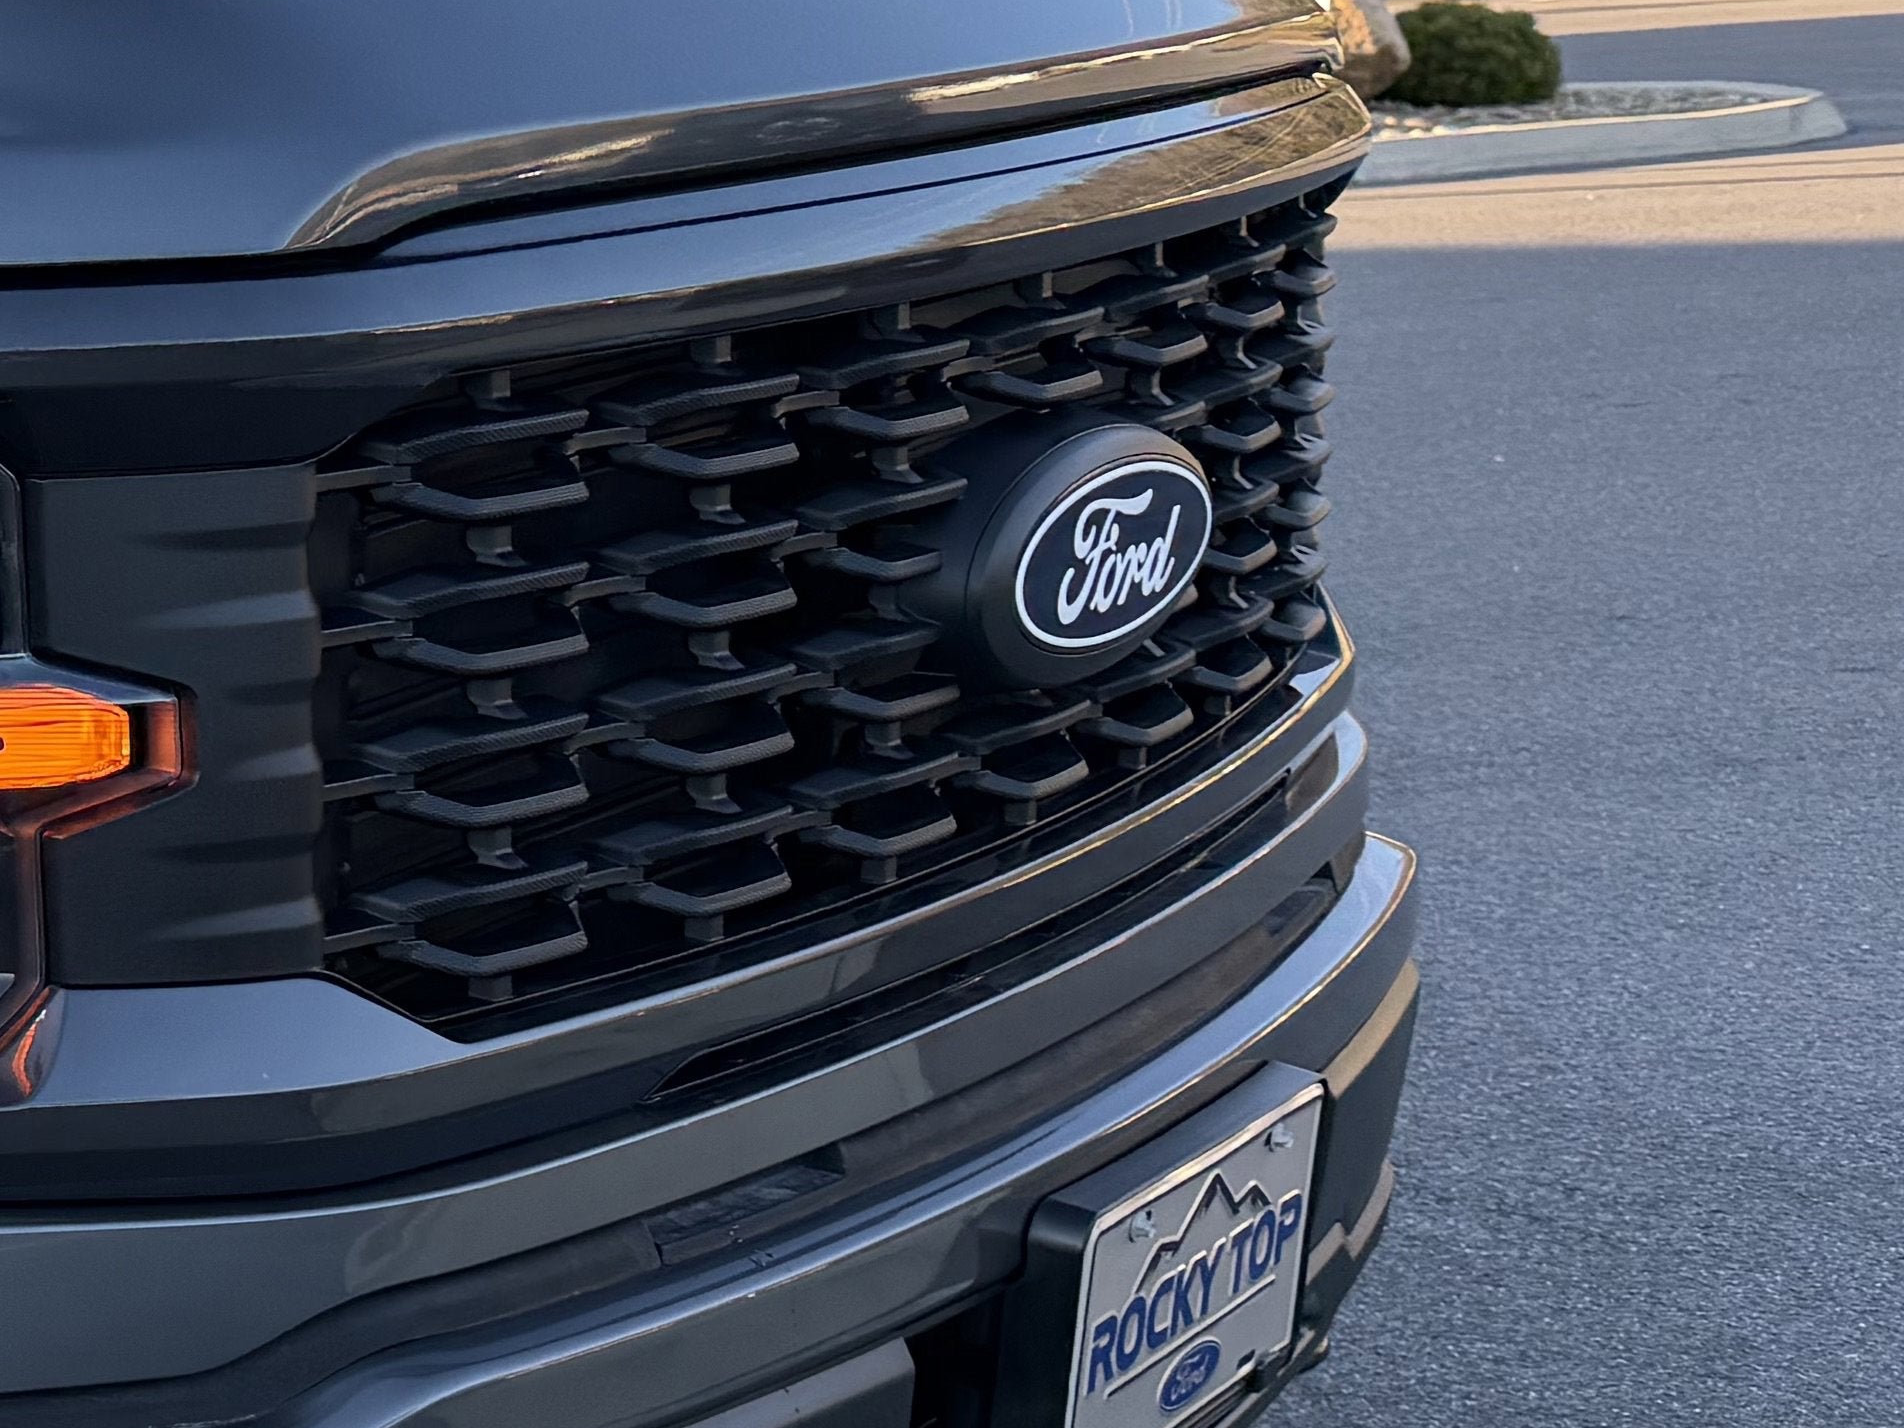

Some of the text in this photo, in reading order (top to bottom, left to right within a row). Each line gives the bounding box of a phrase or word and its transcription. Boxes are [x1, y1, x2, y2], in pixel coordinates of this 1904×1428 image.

[1056, 487, 1182, 626] Ford
[1084, 1188, 1304, 1395] ROCKY TOP
